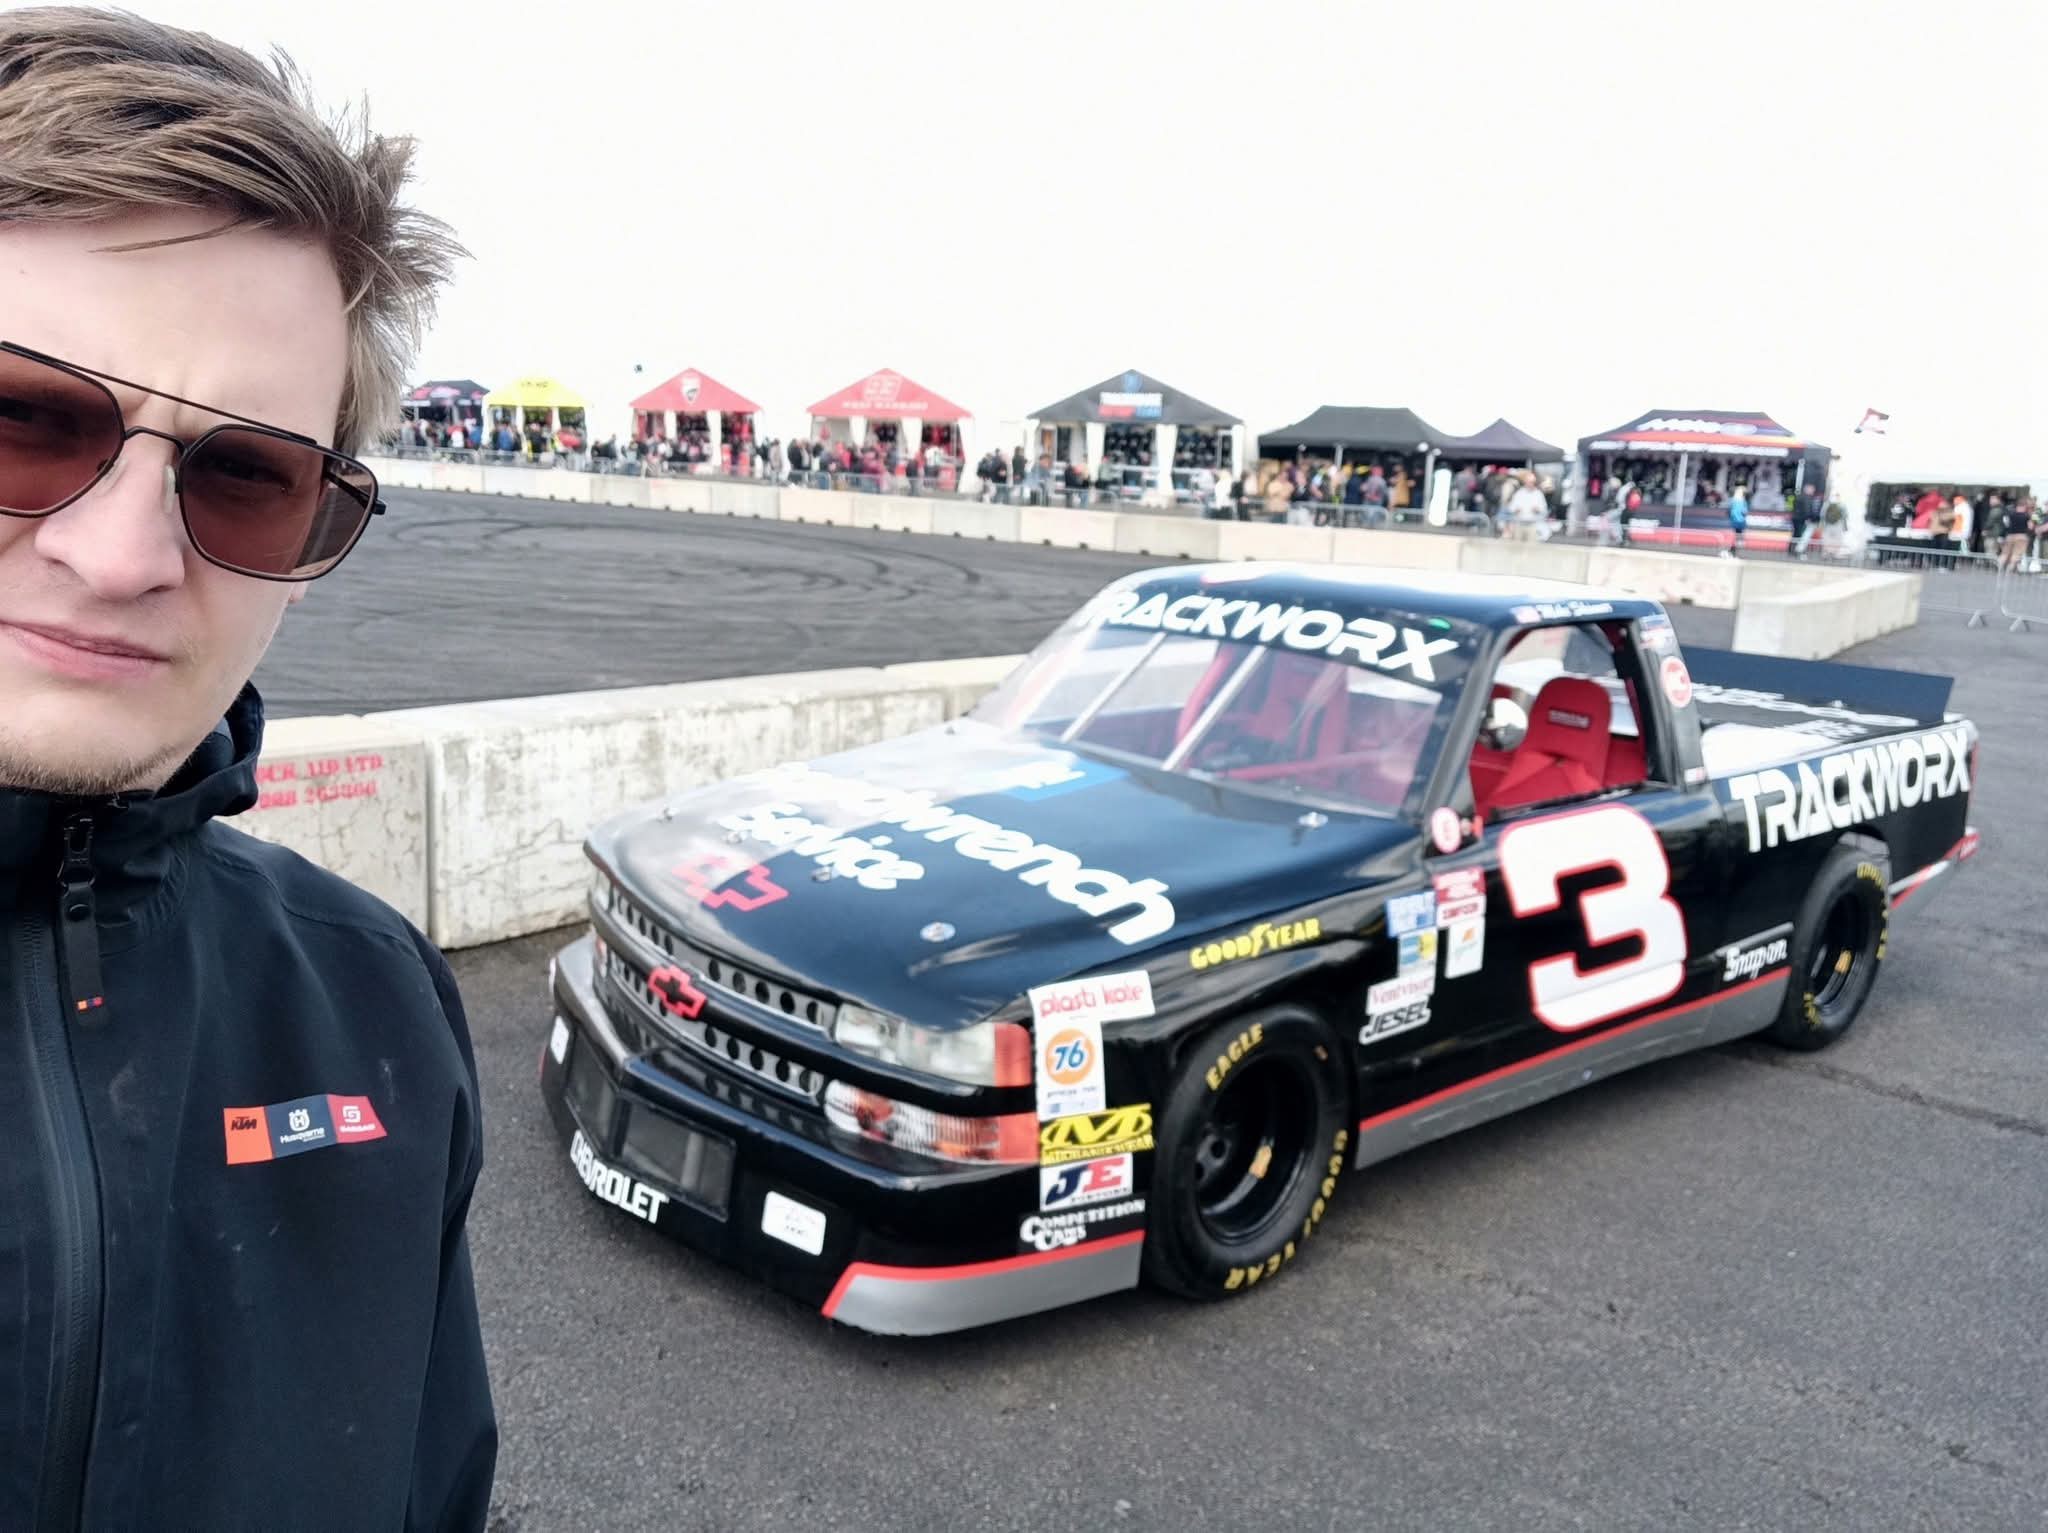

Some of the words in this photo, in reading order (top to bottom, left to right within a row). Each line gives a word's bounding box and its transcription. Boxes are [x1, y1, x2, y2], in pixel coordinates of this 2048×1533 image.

[1727, 727, 1971, 853] TRACKWORX
[1495, 802, 1689, 1032] 3
[1040, 988, 1097, 1018] plasti
[1364, 1000, 1428, 1039] JESEL
[1055, 1040, 1085, 1071] 76
[1205, 1023, 1264, 1091] EAGLE
[231, 1116, 258, 1131] KTM
[280, 1127, 326, 1144] Husqvarna
[1045, 1157, 1125, 1206] JE
